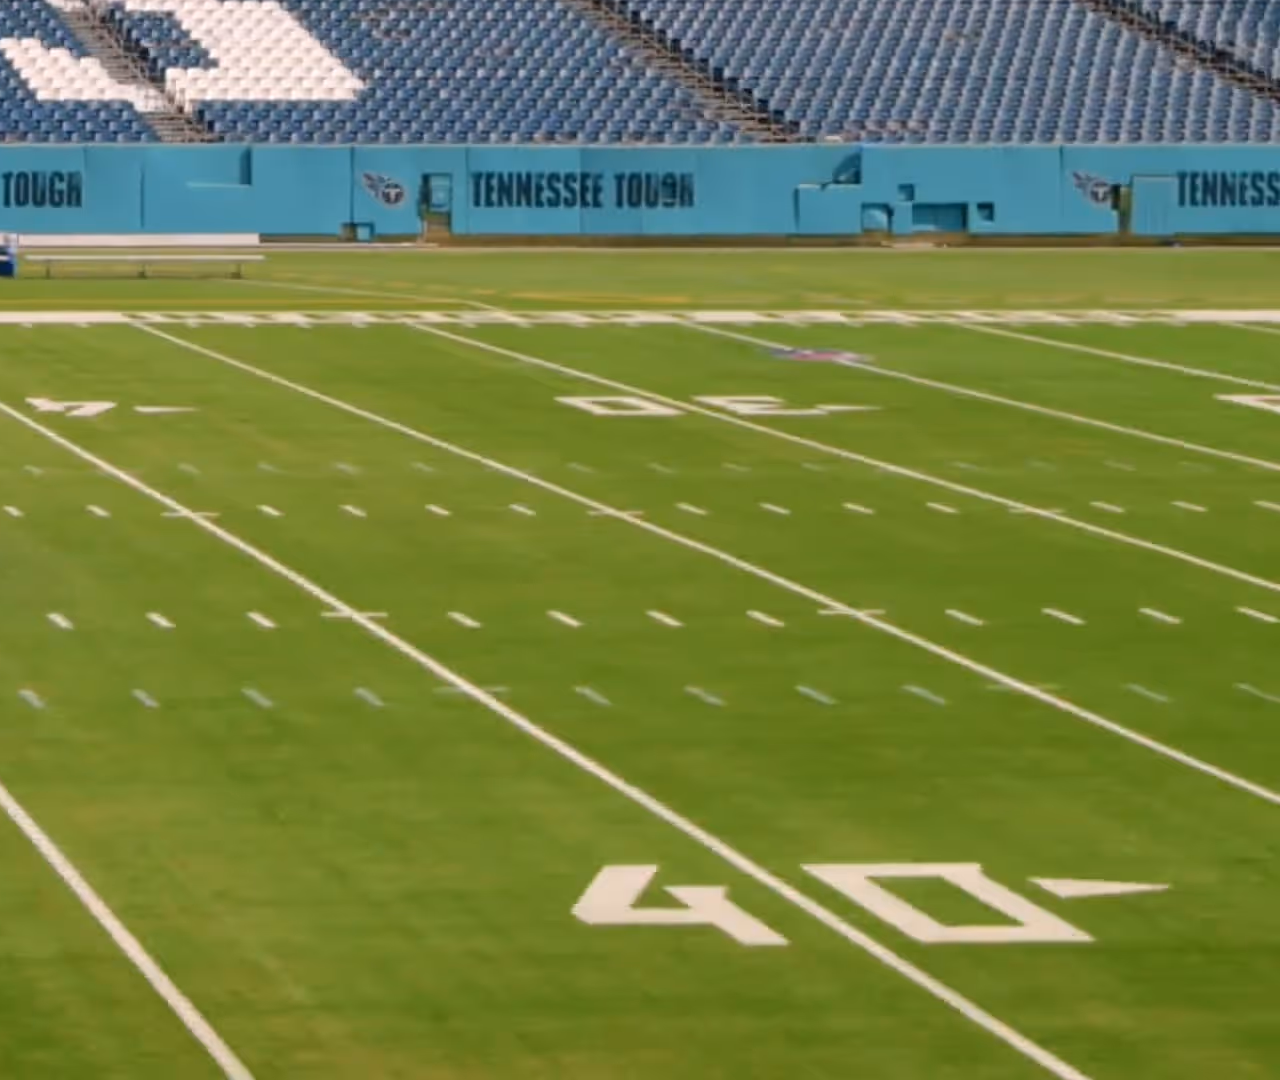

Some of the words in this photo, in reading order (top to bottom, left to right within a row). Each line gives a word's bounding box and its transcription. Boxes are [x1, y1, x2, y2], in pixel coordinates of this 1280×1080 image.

[1, 171, 83, 208] TOUGH
[471, 172, 604, 209] TENNESSEE
[570, 862, 1096, 946] 40
